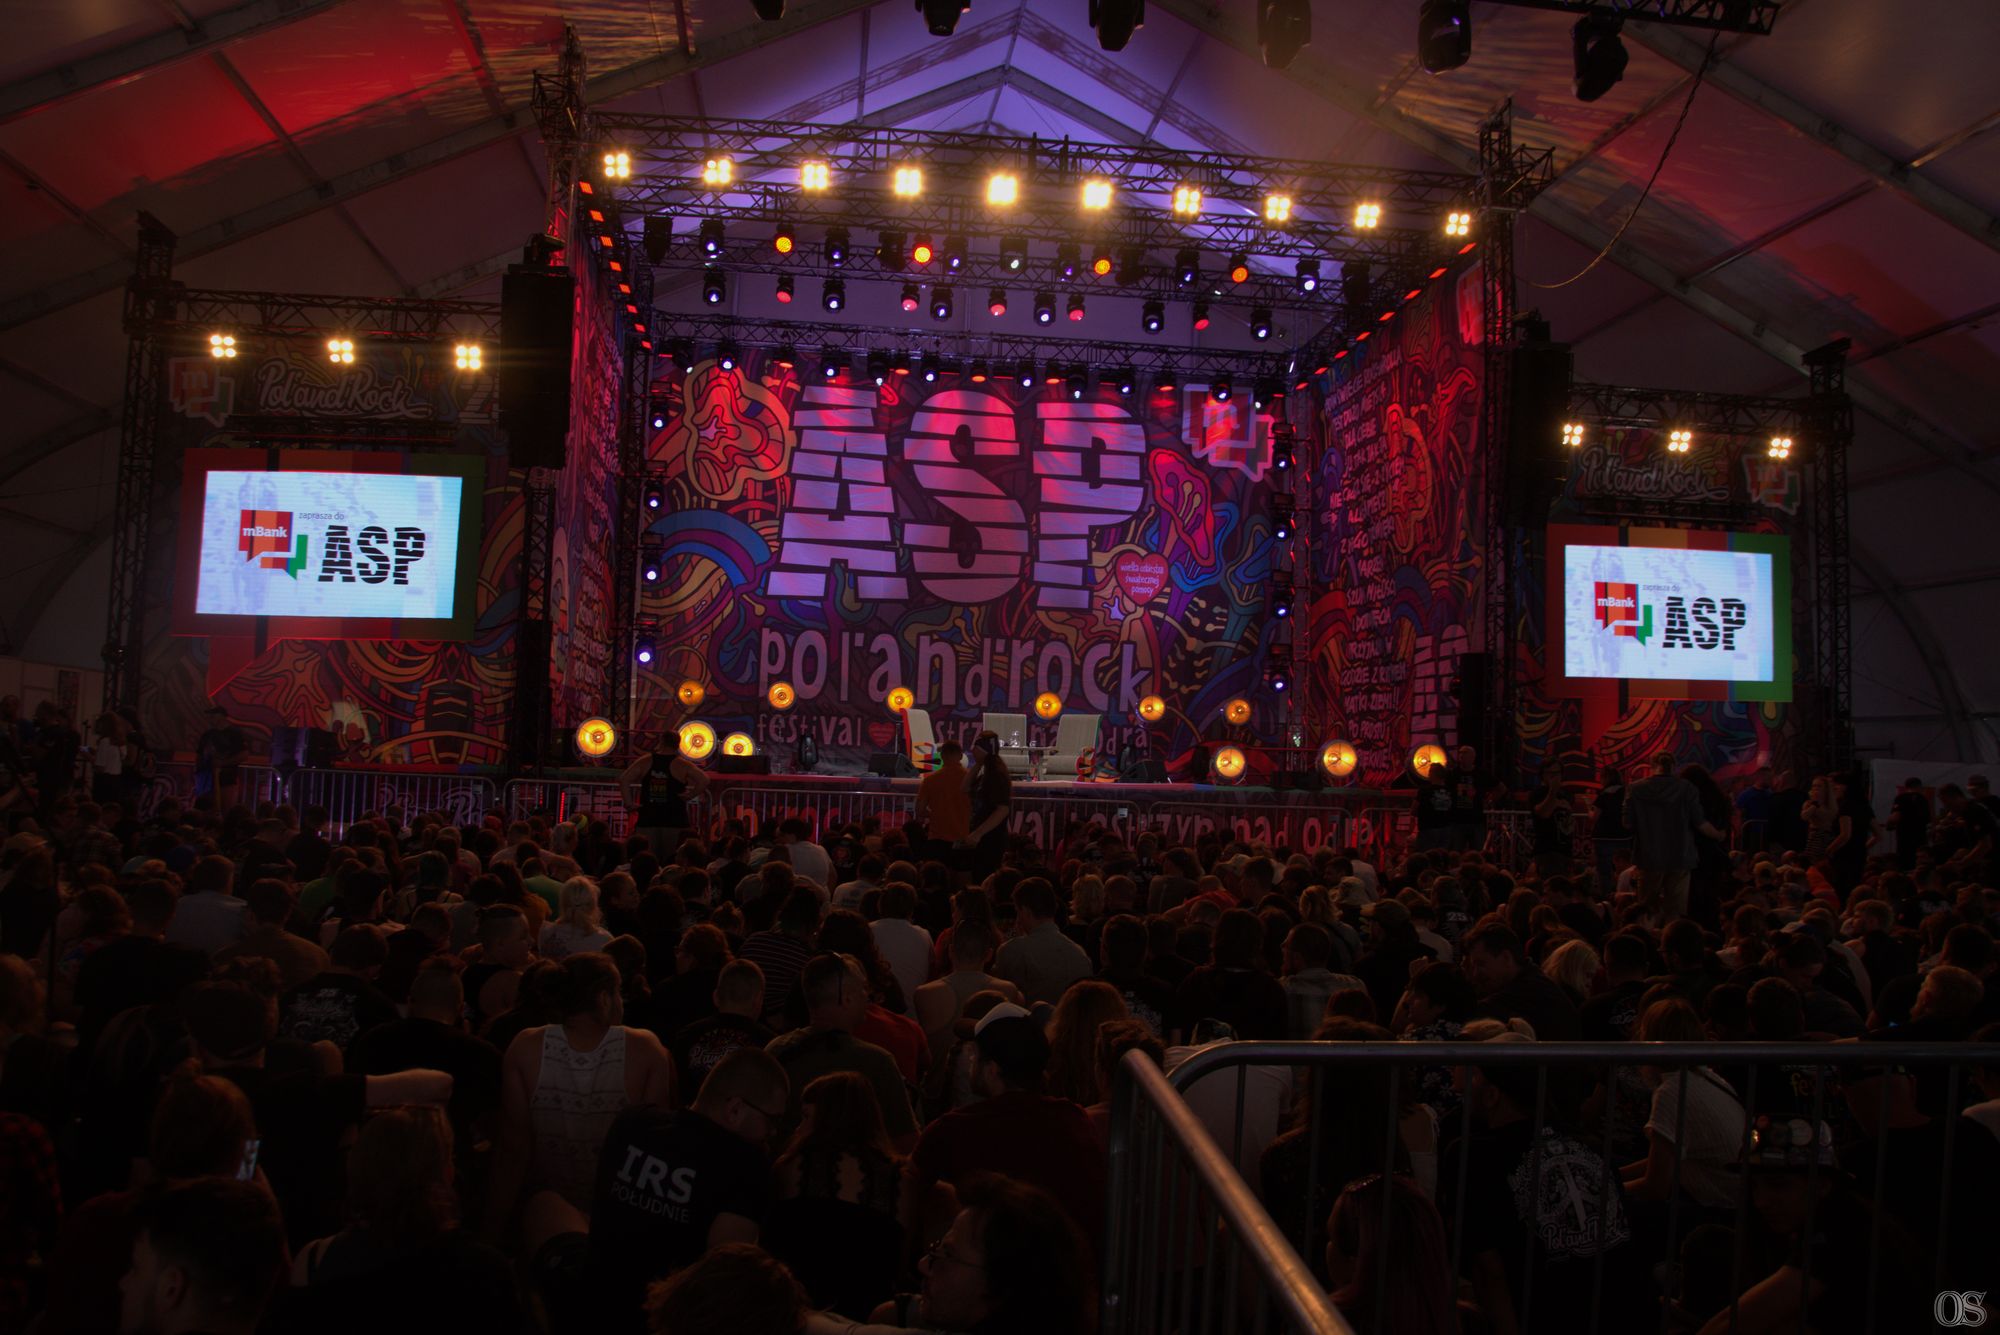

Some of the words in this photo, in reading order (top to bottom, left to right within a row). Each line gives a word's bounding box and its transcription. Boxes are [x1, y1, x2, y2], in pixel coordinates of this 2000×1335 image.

[298, 511, 333, 521] zaprasza
[334, 512, 345, 520] do
[766, 384, 1147, 611] ASP
[242, 526, 288, 538] mBank
[317, 525, 426, 585] ASP
[1597, 596, 1635, 608] mBank
[1662, 596, 1747, 650] ASP
[757, 713, 862, 746] festival
[616, 1143, 696, 1204] IRS
